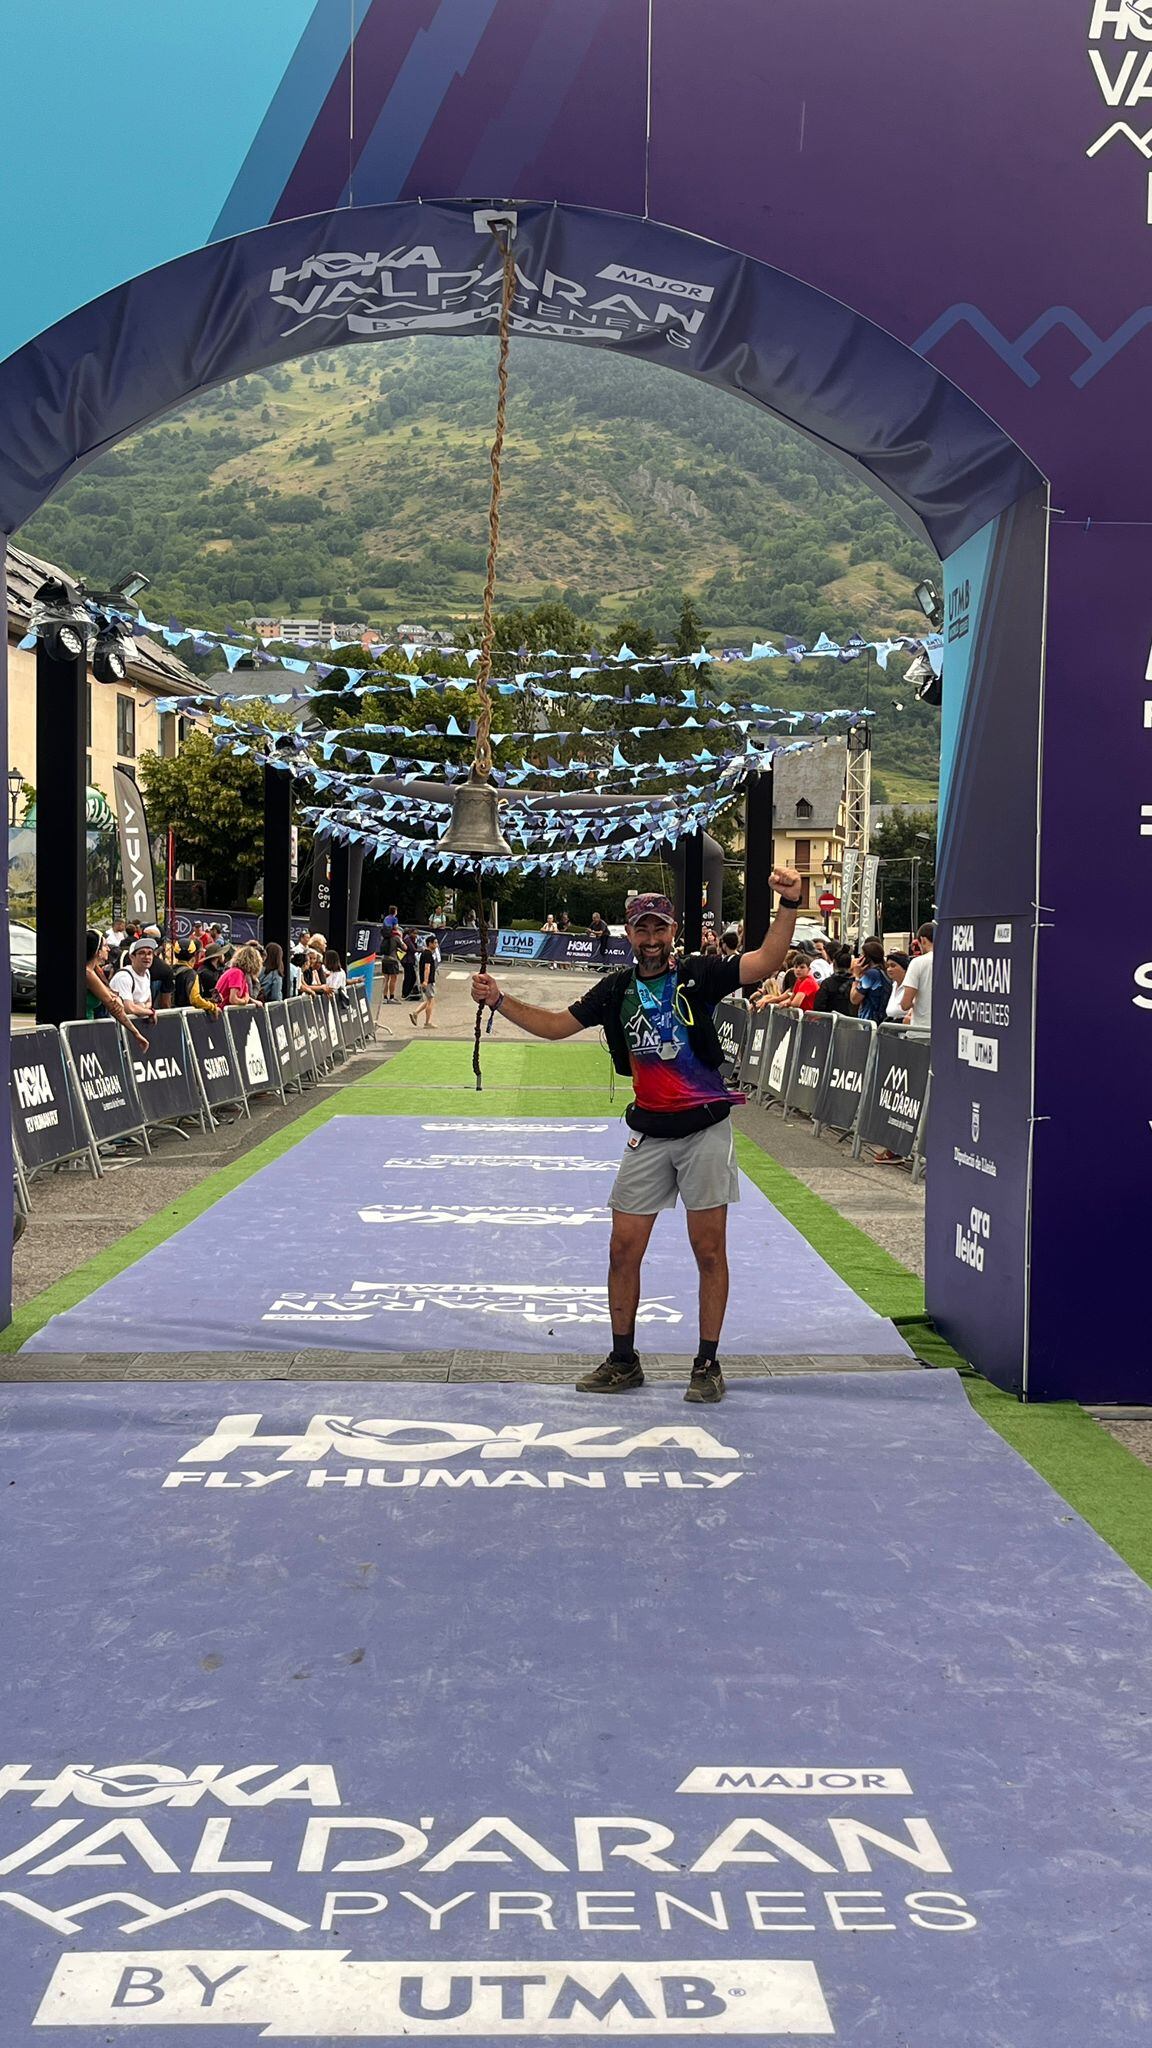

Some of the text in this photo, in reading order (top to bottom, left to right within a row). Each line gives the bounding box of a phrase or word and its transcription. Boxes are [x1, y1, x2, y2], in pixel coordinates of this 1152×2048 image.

[269, 246, 441, 292] HOKA
[616, 270, 702, 297] MAJOR
[372, 318, 417, 331] BY
[442, 286, 692, 349] PYRENEES
[503, 936, 534, 947] UTMB
[568, 941, 592, 952] HOKA
[952, 925, 975, 951] HOKA
[971, 1001, 1010, 1027] PYRENEES
[975, 1042, 994, 1064] UTMB
[133, 1056, 182, 1083] DACIA
[204, 1055, 230, 1081] SUUNTO
[830, 1068, 863, 1093] DACIA
[13, 1064, 55, 1109] HOKA
[970, 1206, 991, 1239] ara
[955, 1223, 985, 1272] lleida
[177, 1413, 741, 1462] HOKA
[161, 1468, 745, 1488] FLY HUMAN FLY
[0, 1764, 889, 1807] HOKA MAJOR
[320, 1890, 979, 1932] PYRENEES
[109, 1964, 249, 2008] BY
